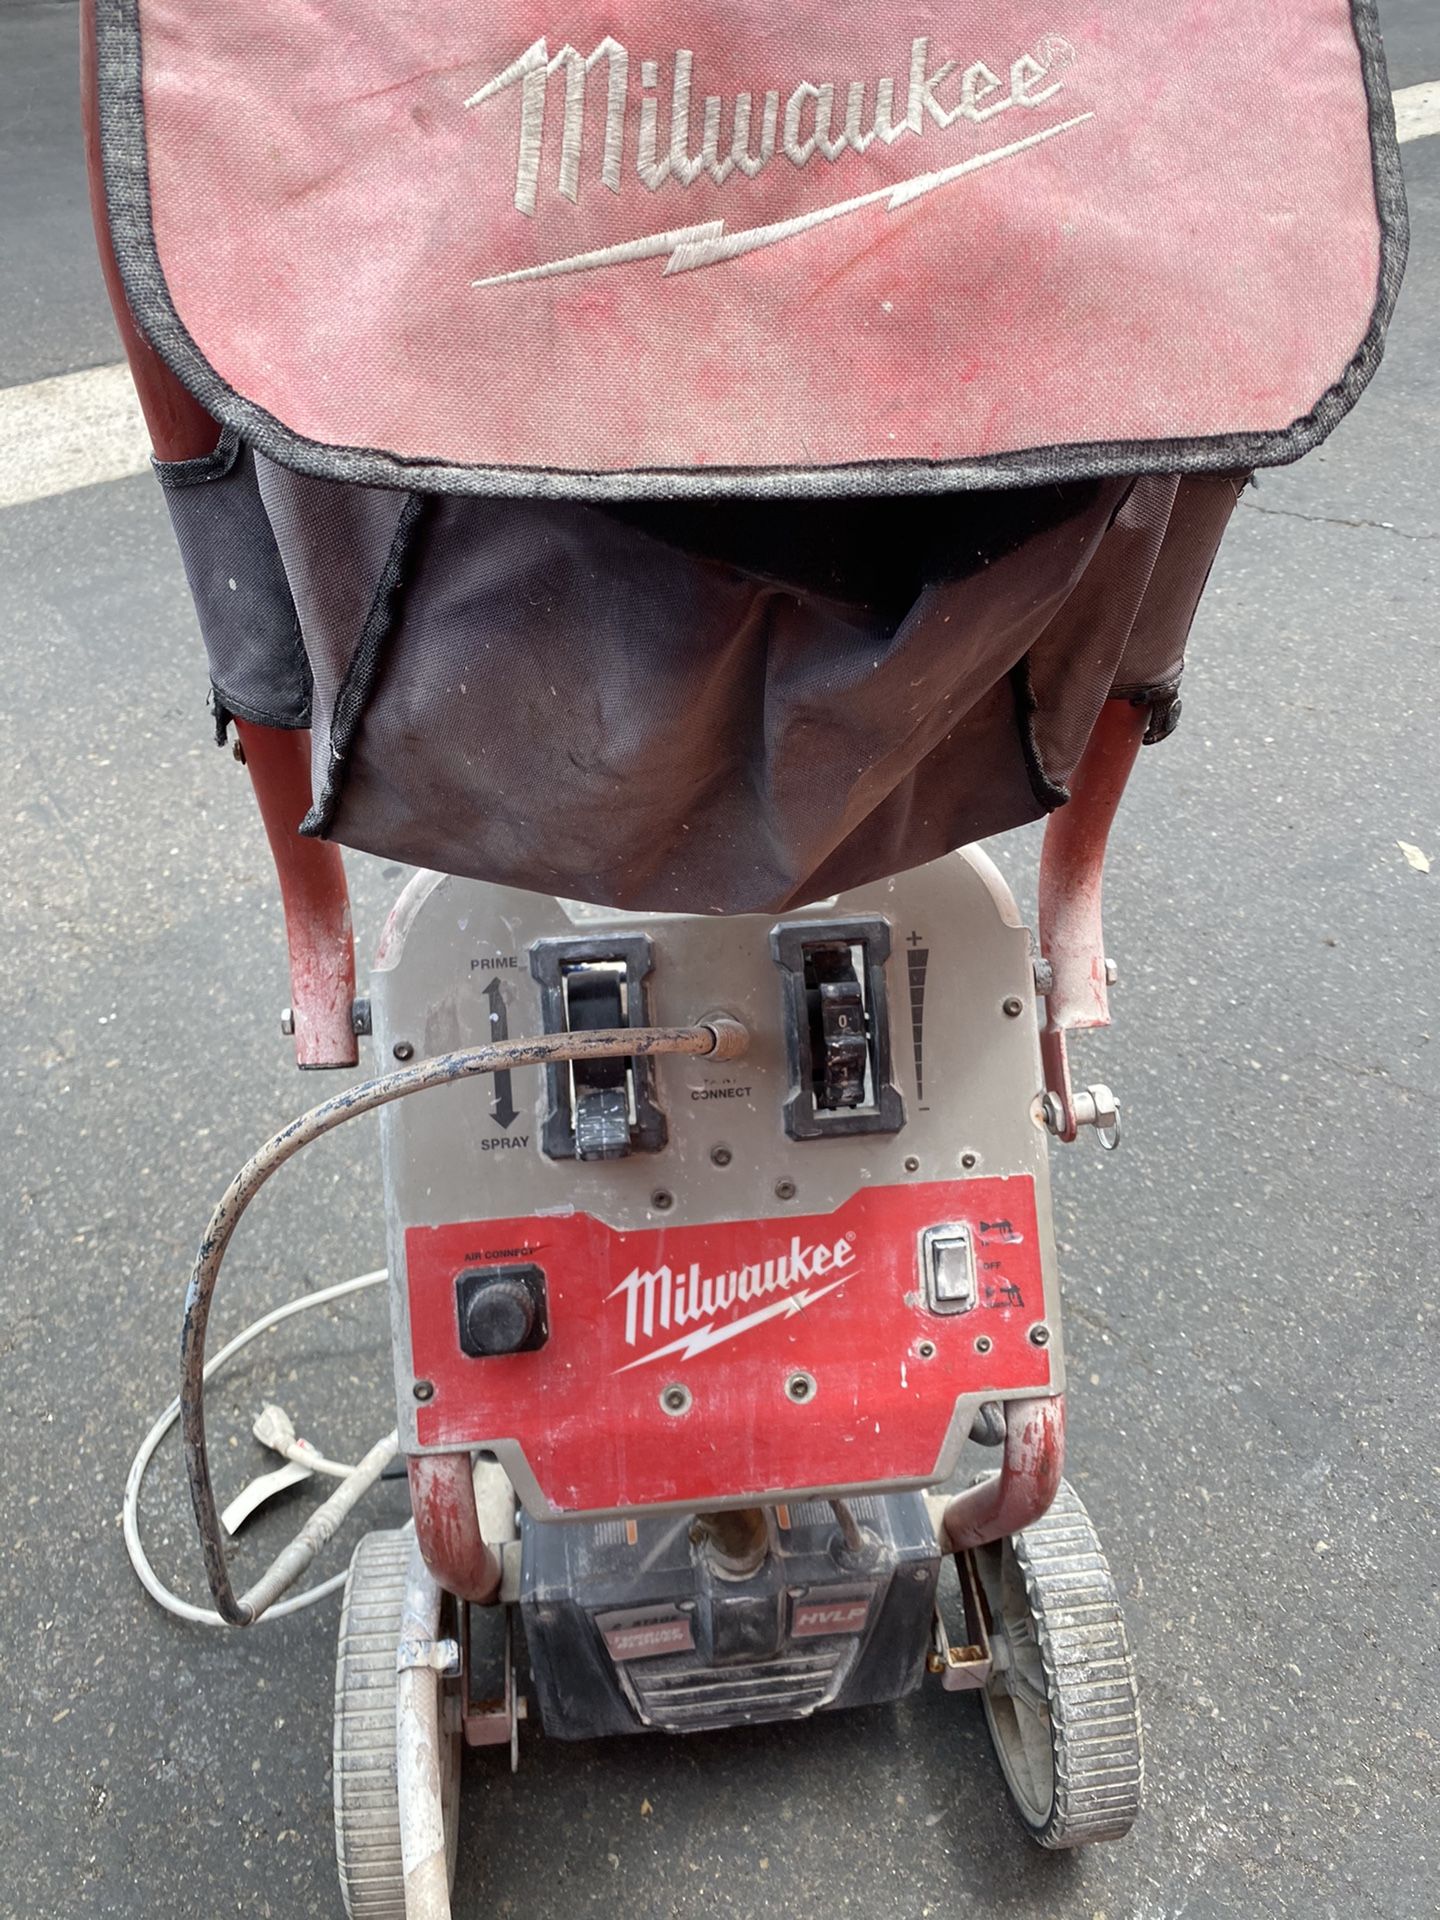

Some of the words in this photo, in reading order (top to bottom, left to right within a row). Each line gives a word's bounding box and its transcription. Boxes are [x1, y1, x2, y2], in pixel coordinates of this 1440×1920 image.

[471, 956, 518, 970] PRIME
[691, 1087, 752, 1100] CONNECT
[481, 1135, 529, 1150] SPRAY
[464, 1251, 482, 1262] AIR
[983, 1261, 1001, 1270] OFF
[799, 1606, 866, 1626] HVLP
